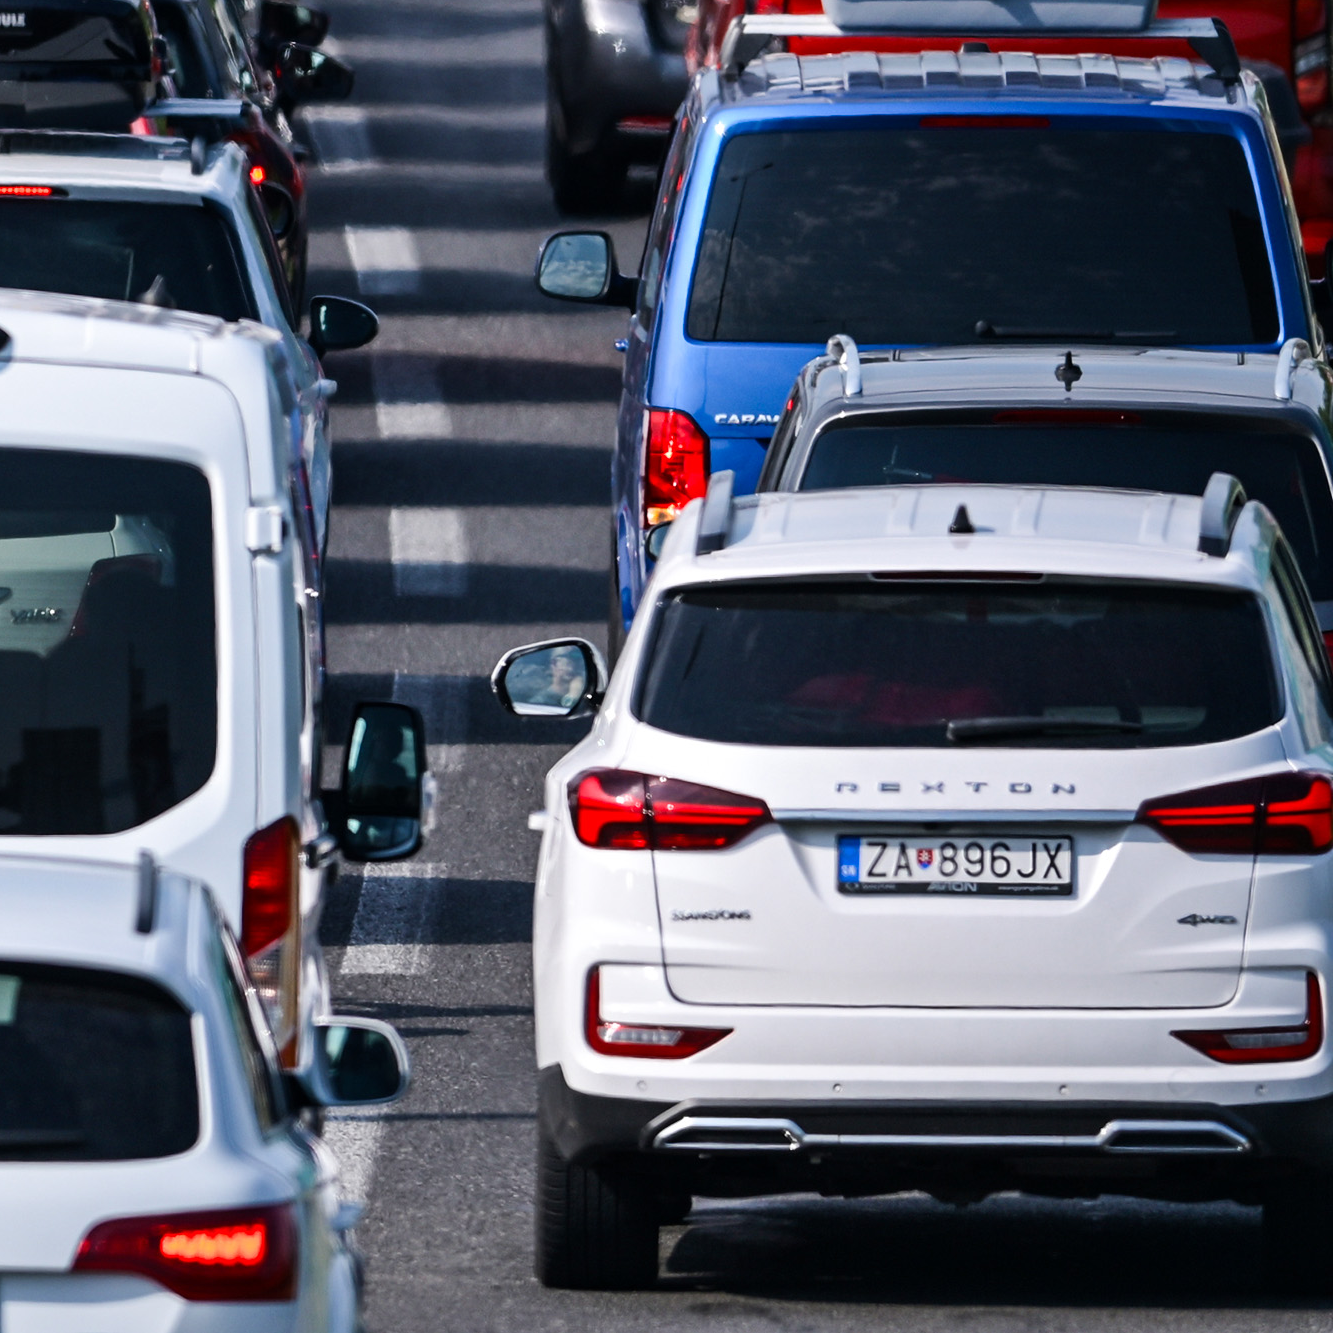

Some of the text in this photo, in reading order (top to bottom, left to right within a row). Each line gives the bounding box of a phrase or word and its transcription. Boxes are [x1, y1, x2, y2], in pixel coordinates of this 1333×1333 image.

[836, 782, 1076, 794] REXTON
[866, 842, 913, 878] ZA
[939, 841, 1063, 879] 896JX
